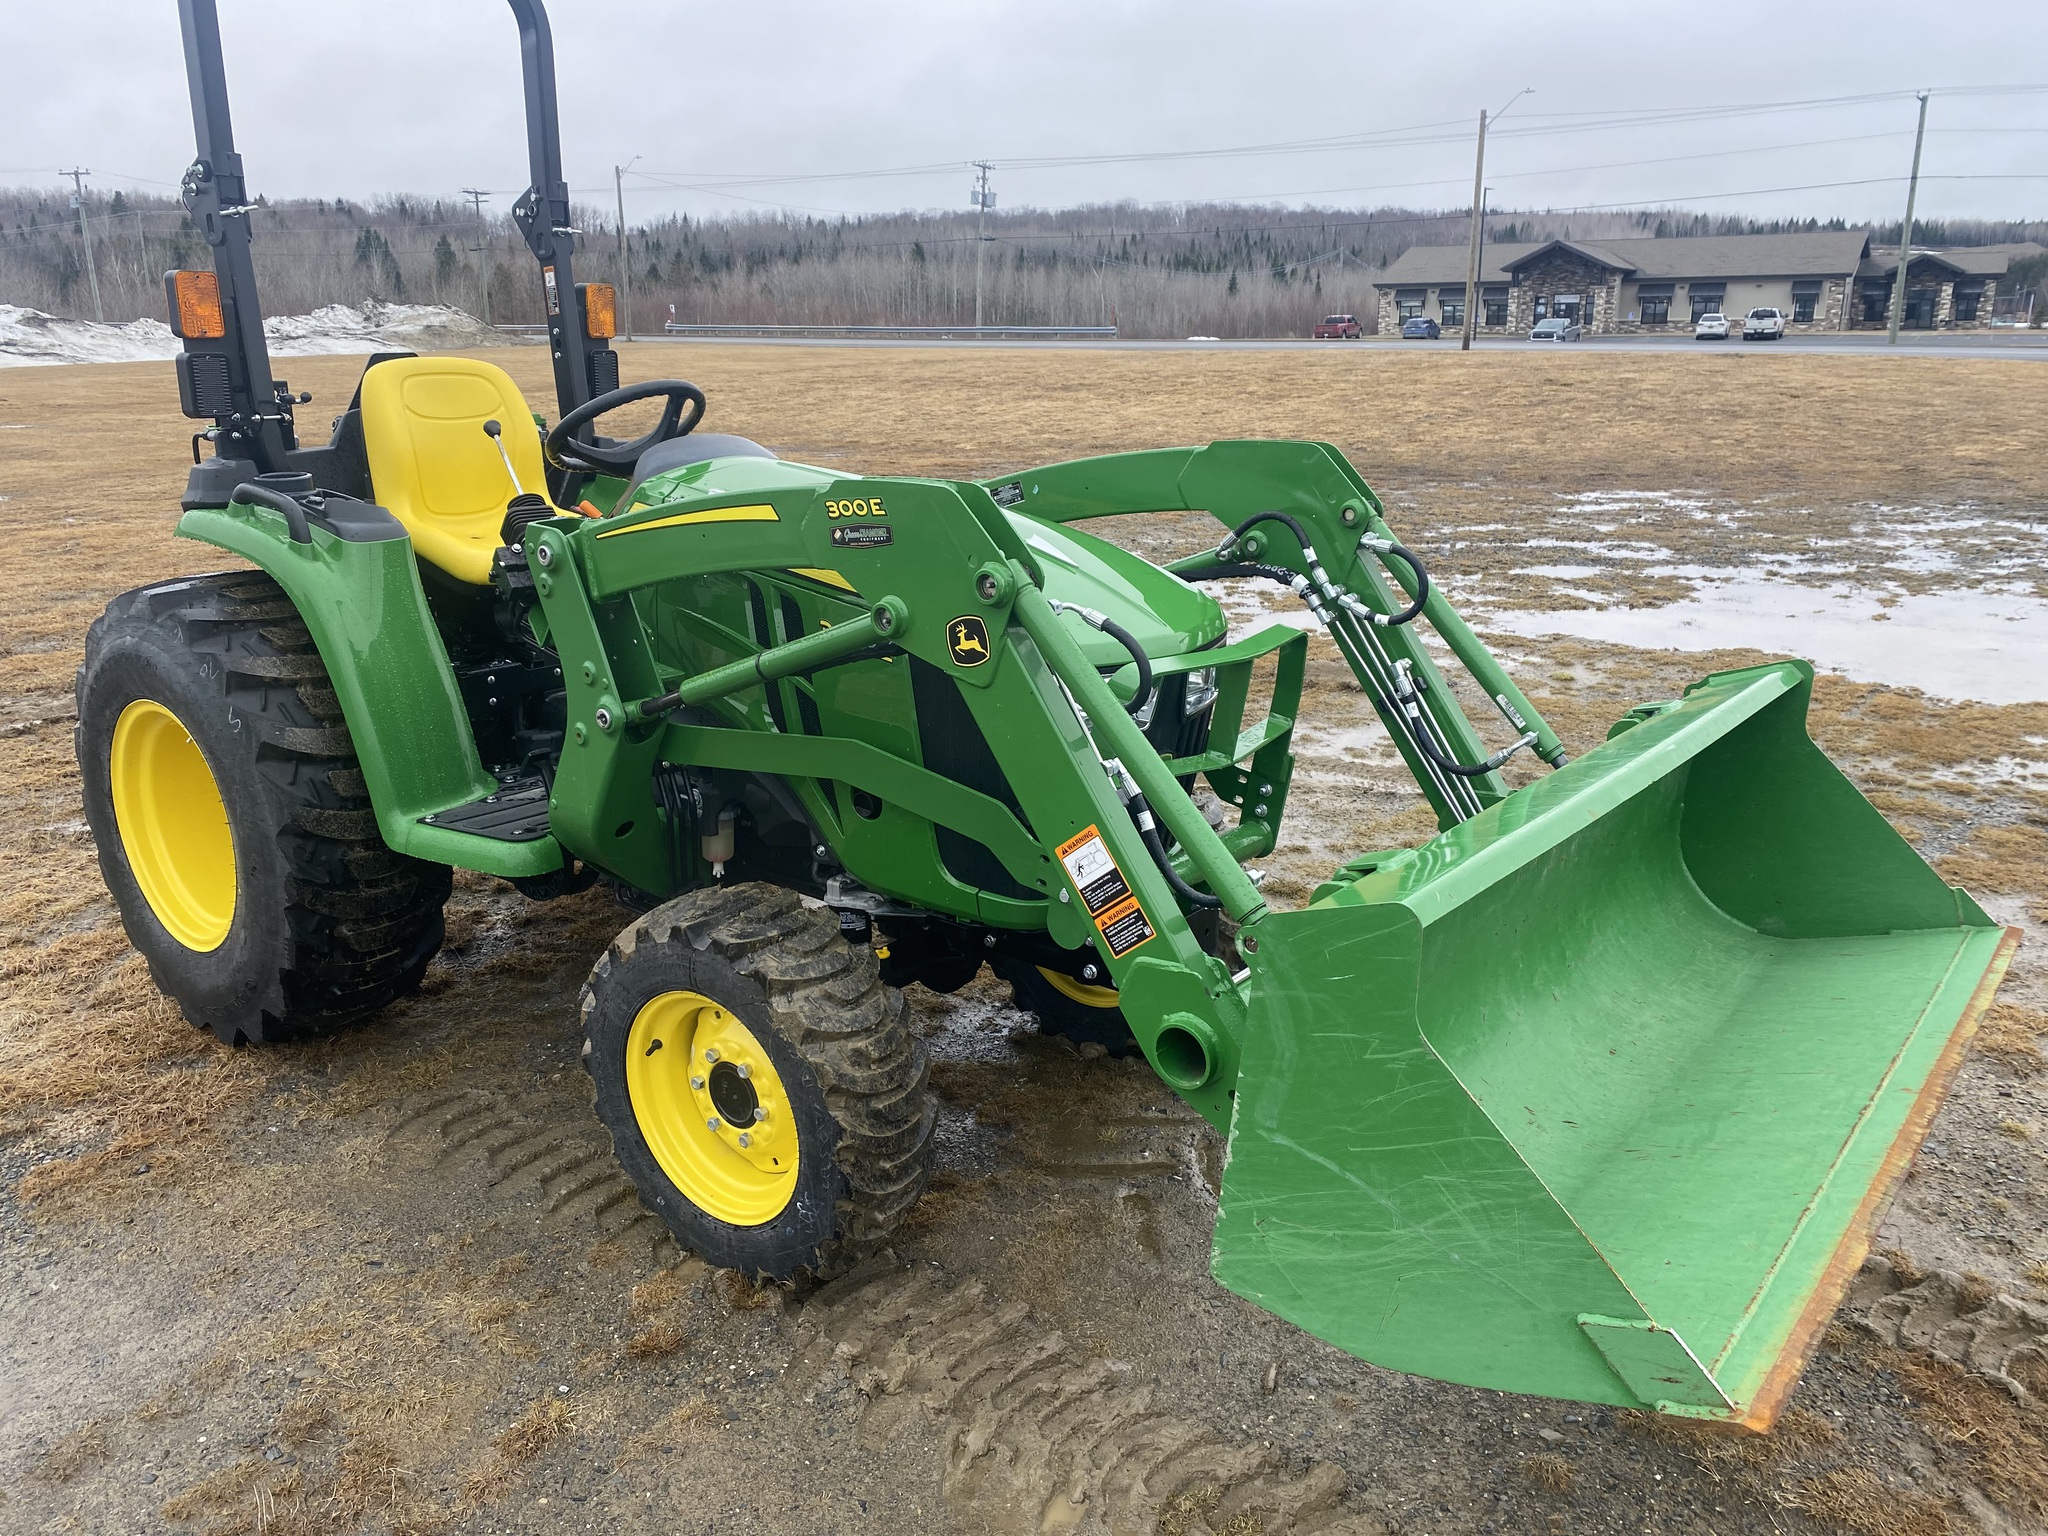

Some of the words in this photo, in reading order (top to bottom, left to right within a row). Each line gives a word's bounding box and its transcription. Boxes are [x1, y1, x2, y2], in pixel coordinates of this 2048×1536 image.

[825, 498, 887, 519] 300E
[1066, 830, 1094, 851] WARNING
[1106, 902, 1135, 922] WARNING
